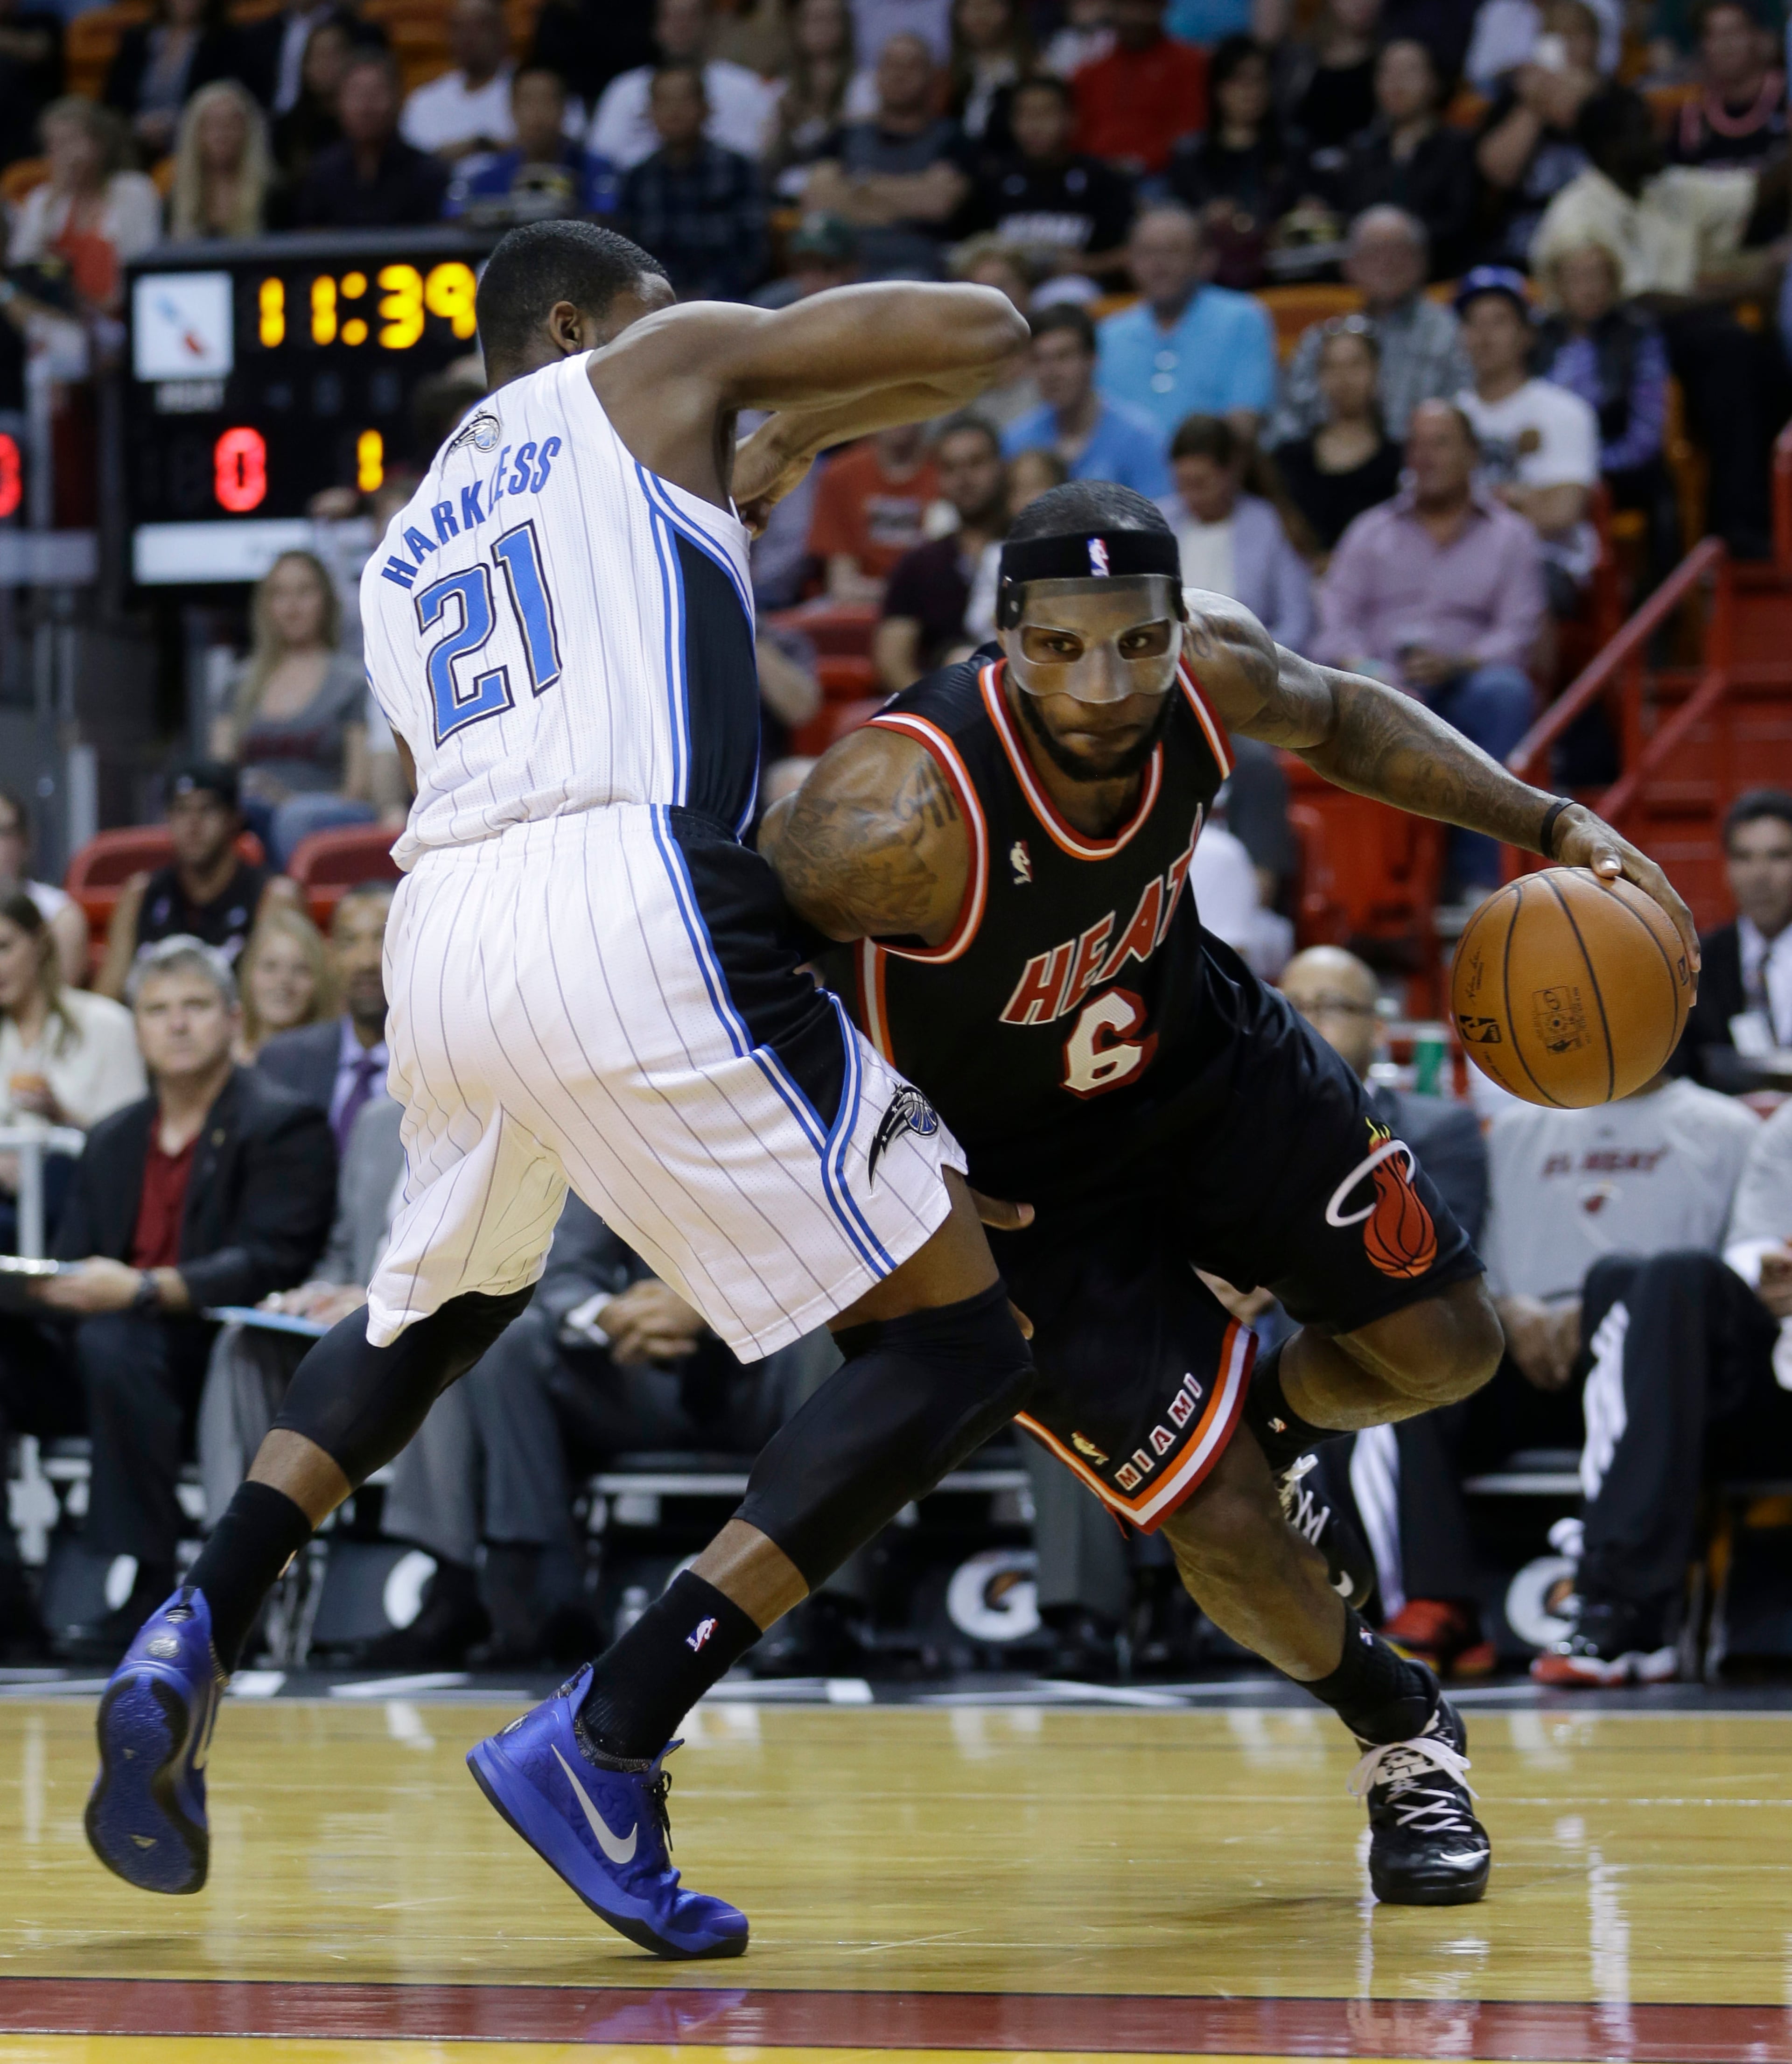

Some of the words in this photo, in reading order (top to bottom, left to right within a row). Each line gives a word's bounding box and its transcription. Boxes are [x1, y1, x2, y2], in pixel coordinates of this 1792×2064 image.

[259, 261, 476, 350] 11:39
[213, 426, 267, 513] 0
[357, 428, 384, 492] 1
[414, 518, 563, 750] 21
[999, 802, 1203, 1025] HEAT
[1058, 986, 1159, 1100] 6
[1114, 1372, 1204, 1491] MIAMI
[946, 1546, 1042, 1642] G
